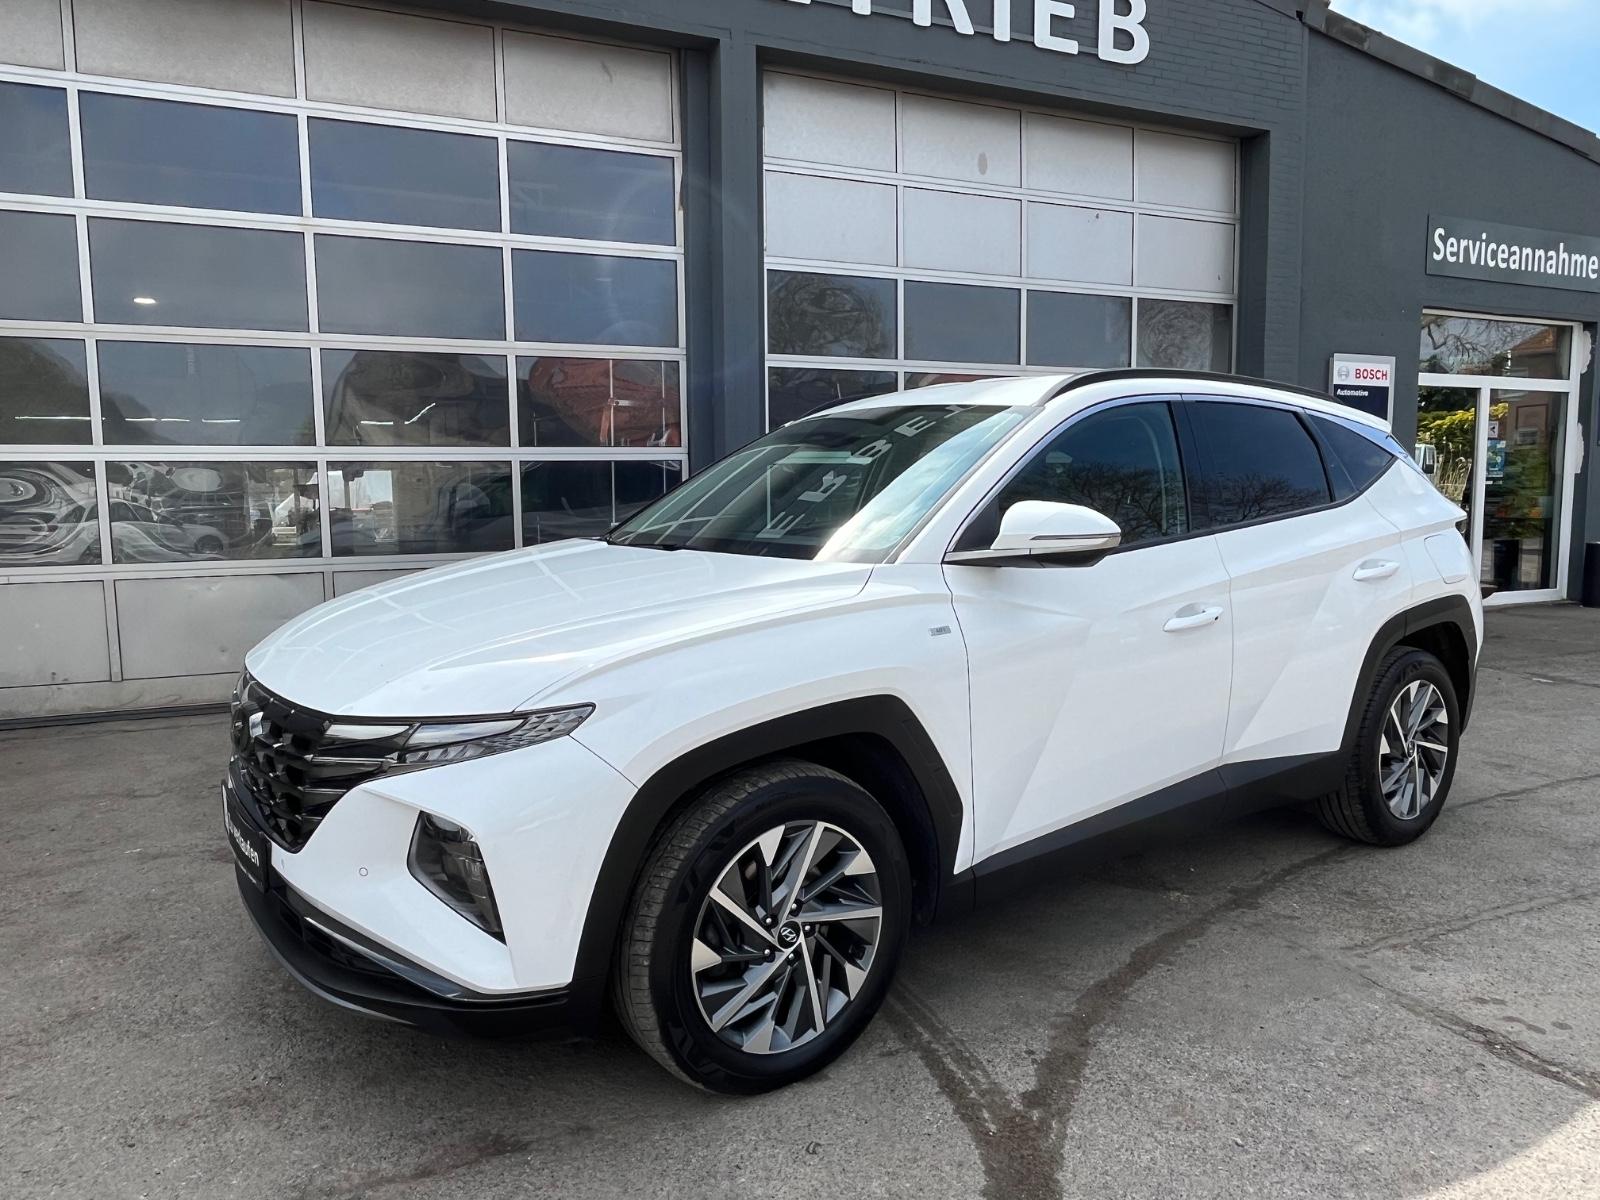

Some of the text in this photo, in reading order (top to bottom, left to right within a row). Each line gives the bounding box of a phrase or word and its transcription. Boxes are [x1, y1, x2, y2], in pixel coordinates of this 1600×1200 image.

[785, 0, 1150, 65] IEB
[1432, 227, 1599, 279] Serviceannahme
[1355, 368, 1388, 381] BOSCH
[1336, 388, 1369, 397] Automotive
